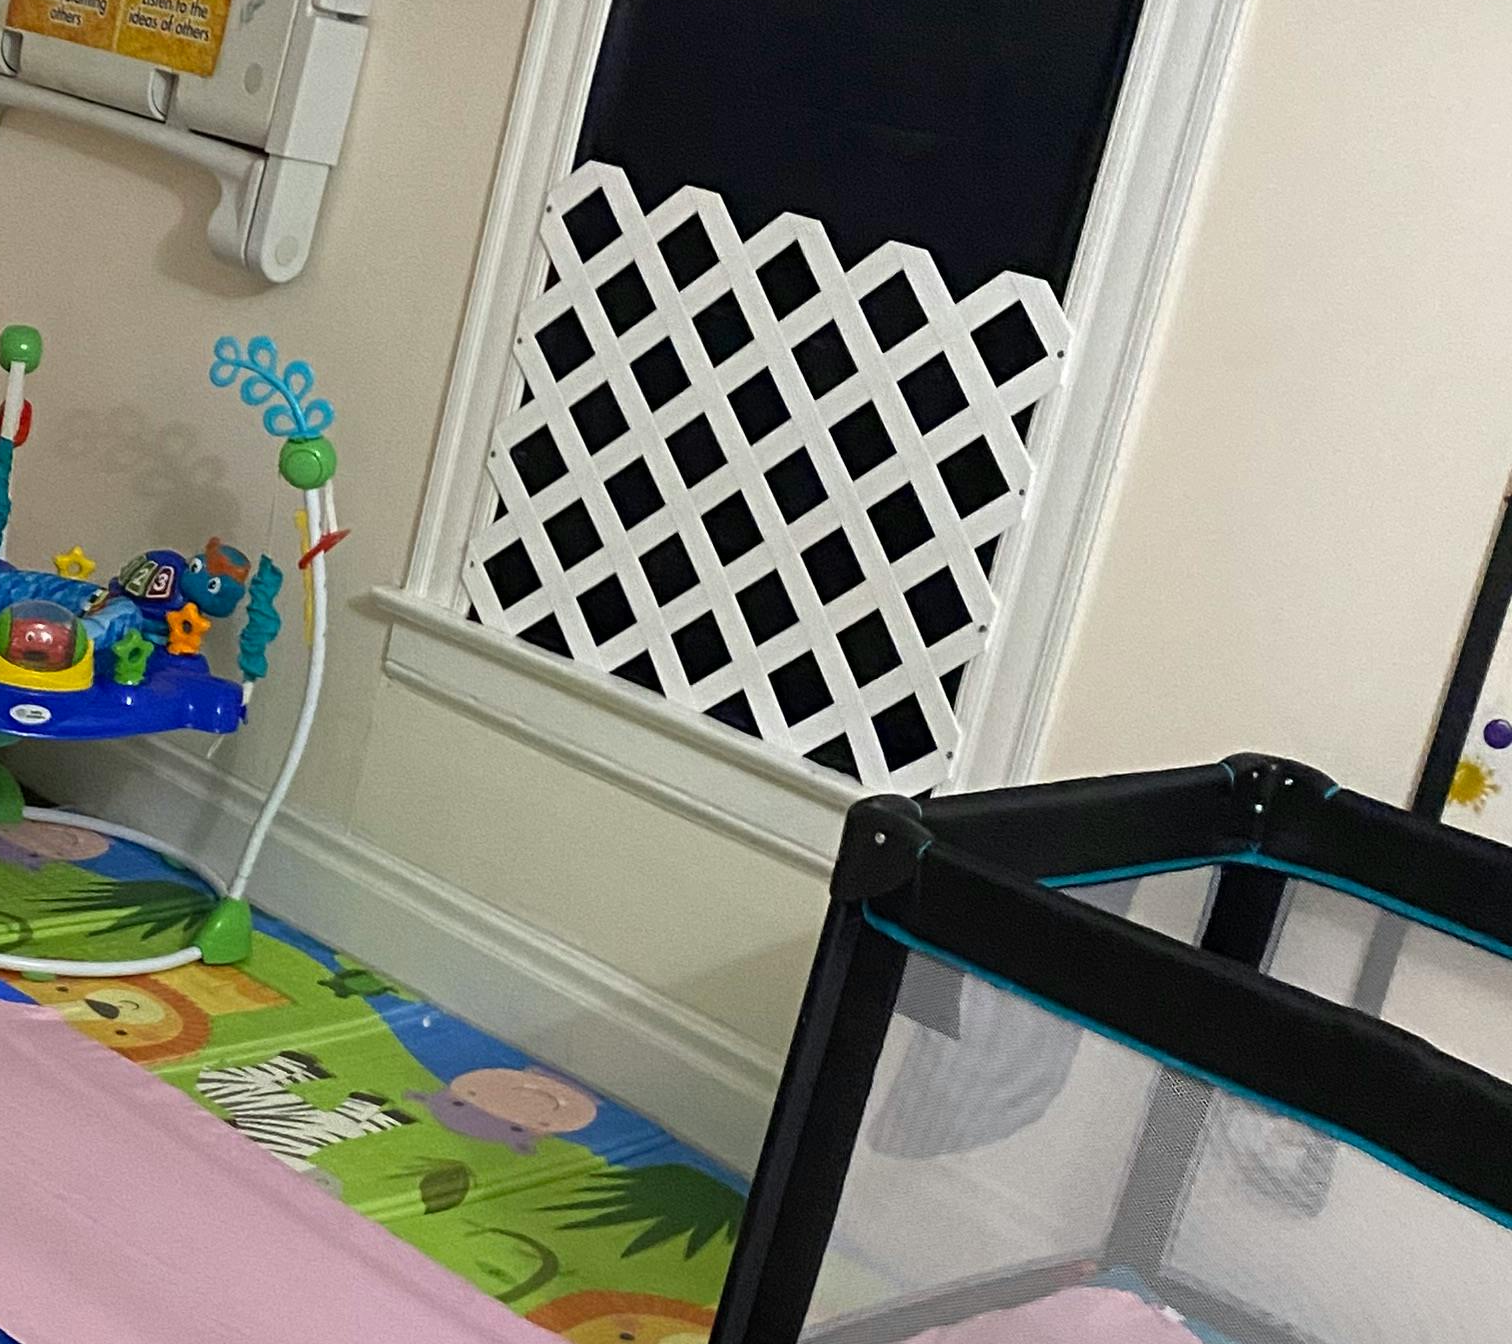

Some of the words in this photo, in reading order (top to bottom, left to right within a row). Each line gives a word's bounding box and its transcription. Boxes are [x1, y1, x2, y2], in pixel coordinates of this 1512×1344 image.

[49, 6, 82, 26] others
[190, 0, 209, 19] the
[129, 7, 159, 27] ideas
[161, 14, 174, 32] of
[175, 19, 210, 42] others
[153, 573, 169, 592] 3
